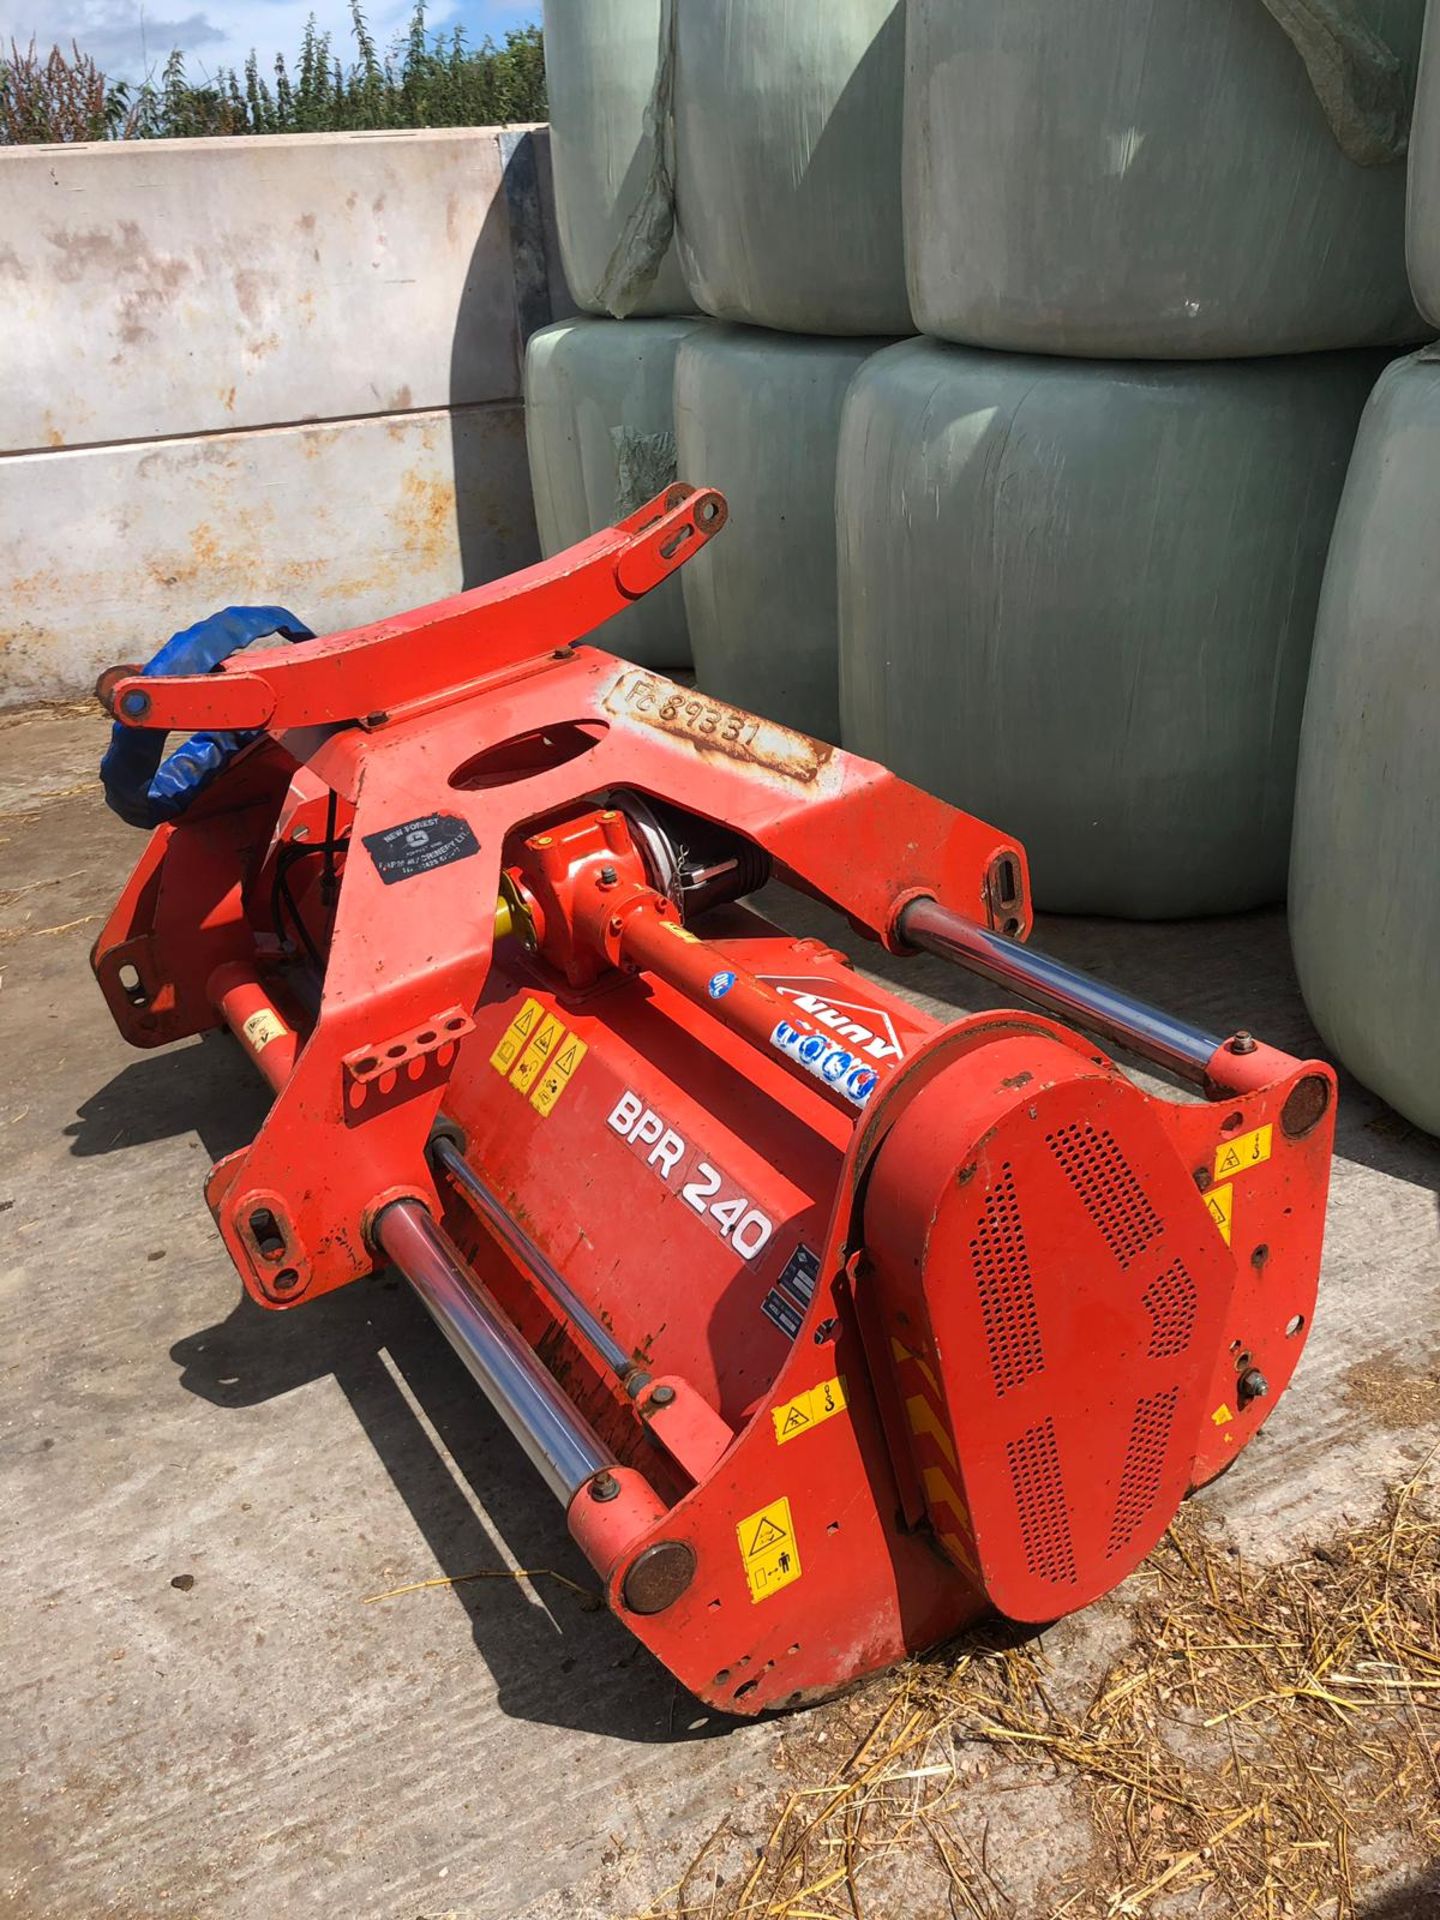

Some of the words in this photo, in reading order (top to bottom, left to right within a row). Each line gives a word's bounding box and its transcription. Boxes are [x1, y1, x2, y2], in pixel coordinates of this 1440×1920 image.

[792, 996, 898, 1059] KUHN
[607, 1090, 685, 1179] BPR
[682, 1162, 773, 1260] 240
